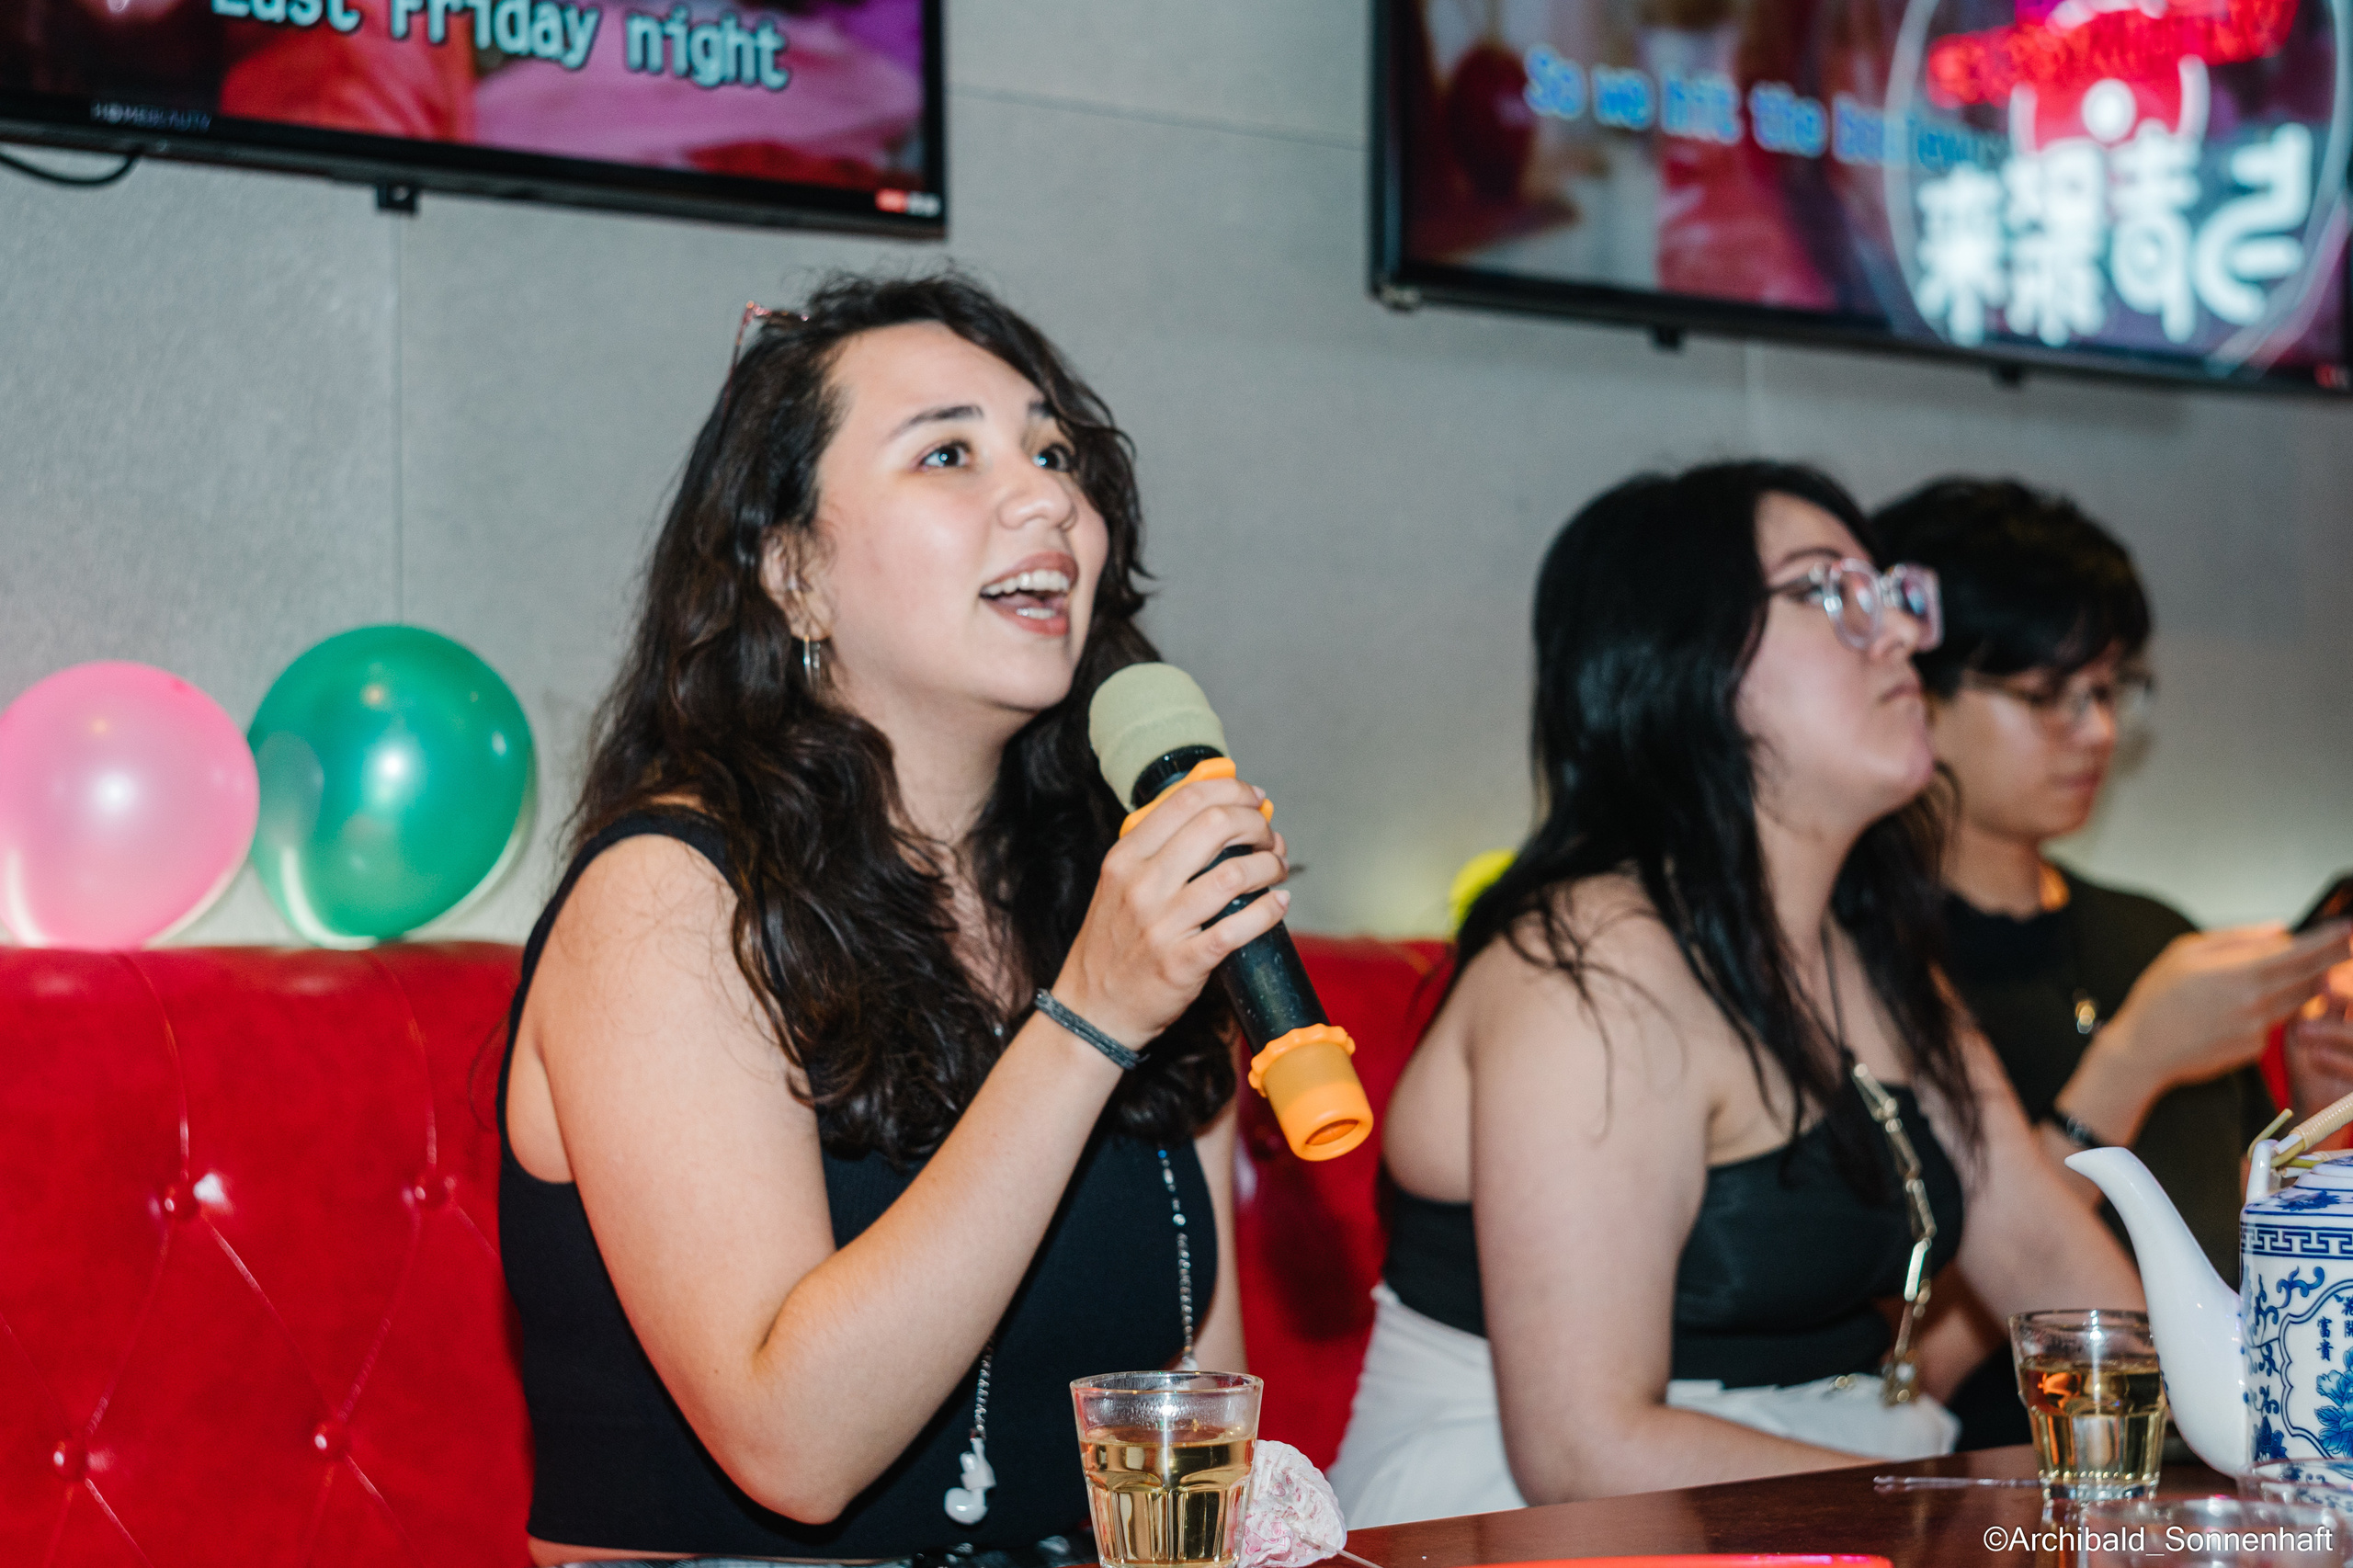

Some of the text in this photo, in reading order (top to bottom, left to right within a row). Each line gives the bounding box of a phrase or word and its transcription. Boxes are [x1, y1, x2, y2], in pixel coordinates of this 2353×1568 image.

[626, 6, 789, 90] night
[1525, 44, 1584, 119] So
[1750, 81, 1827, 157] the
